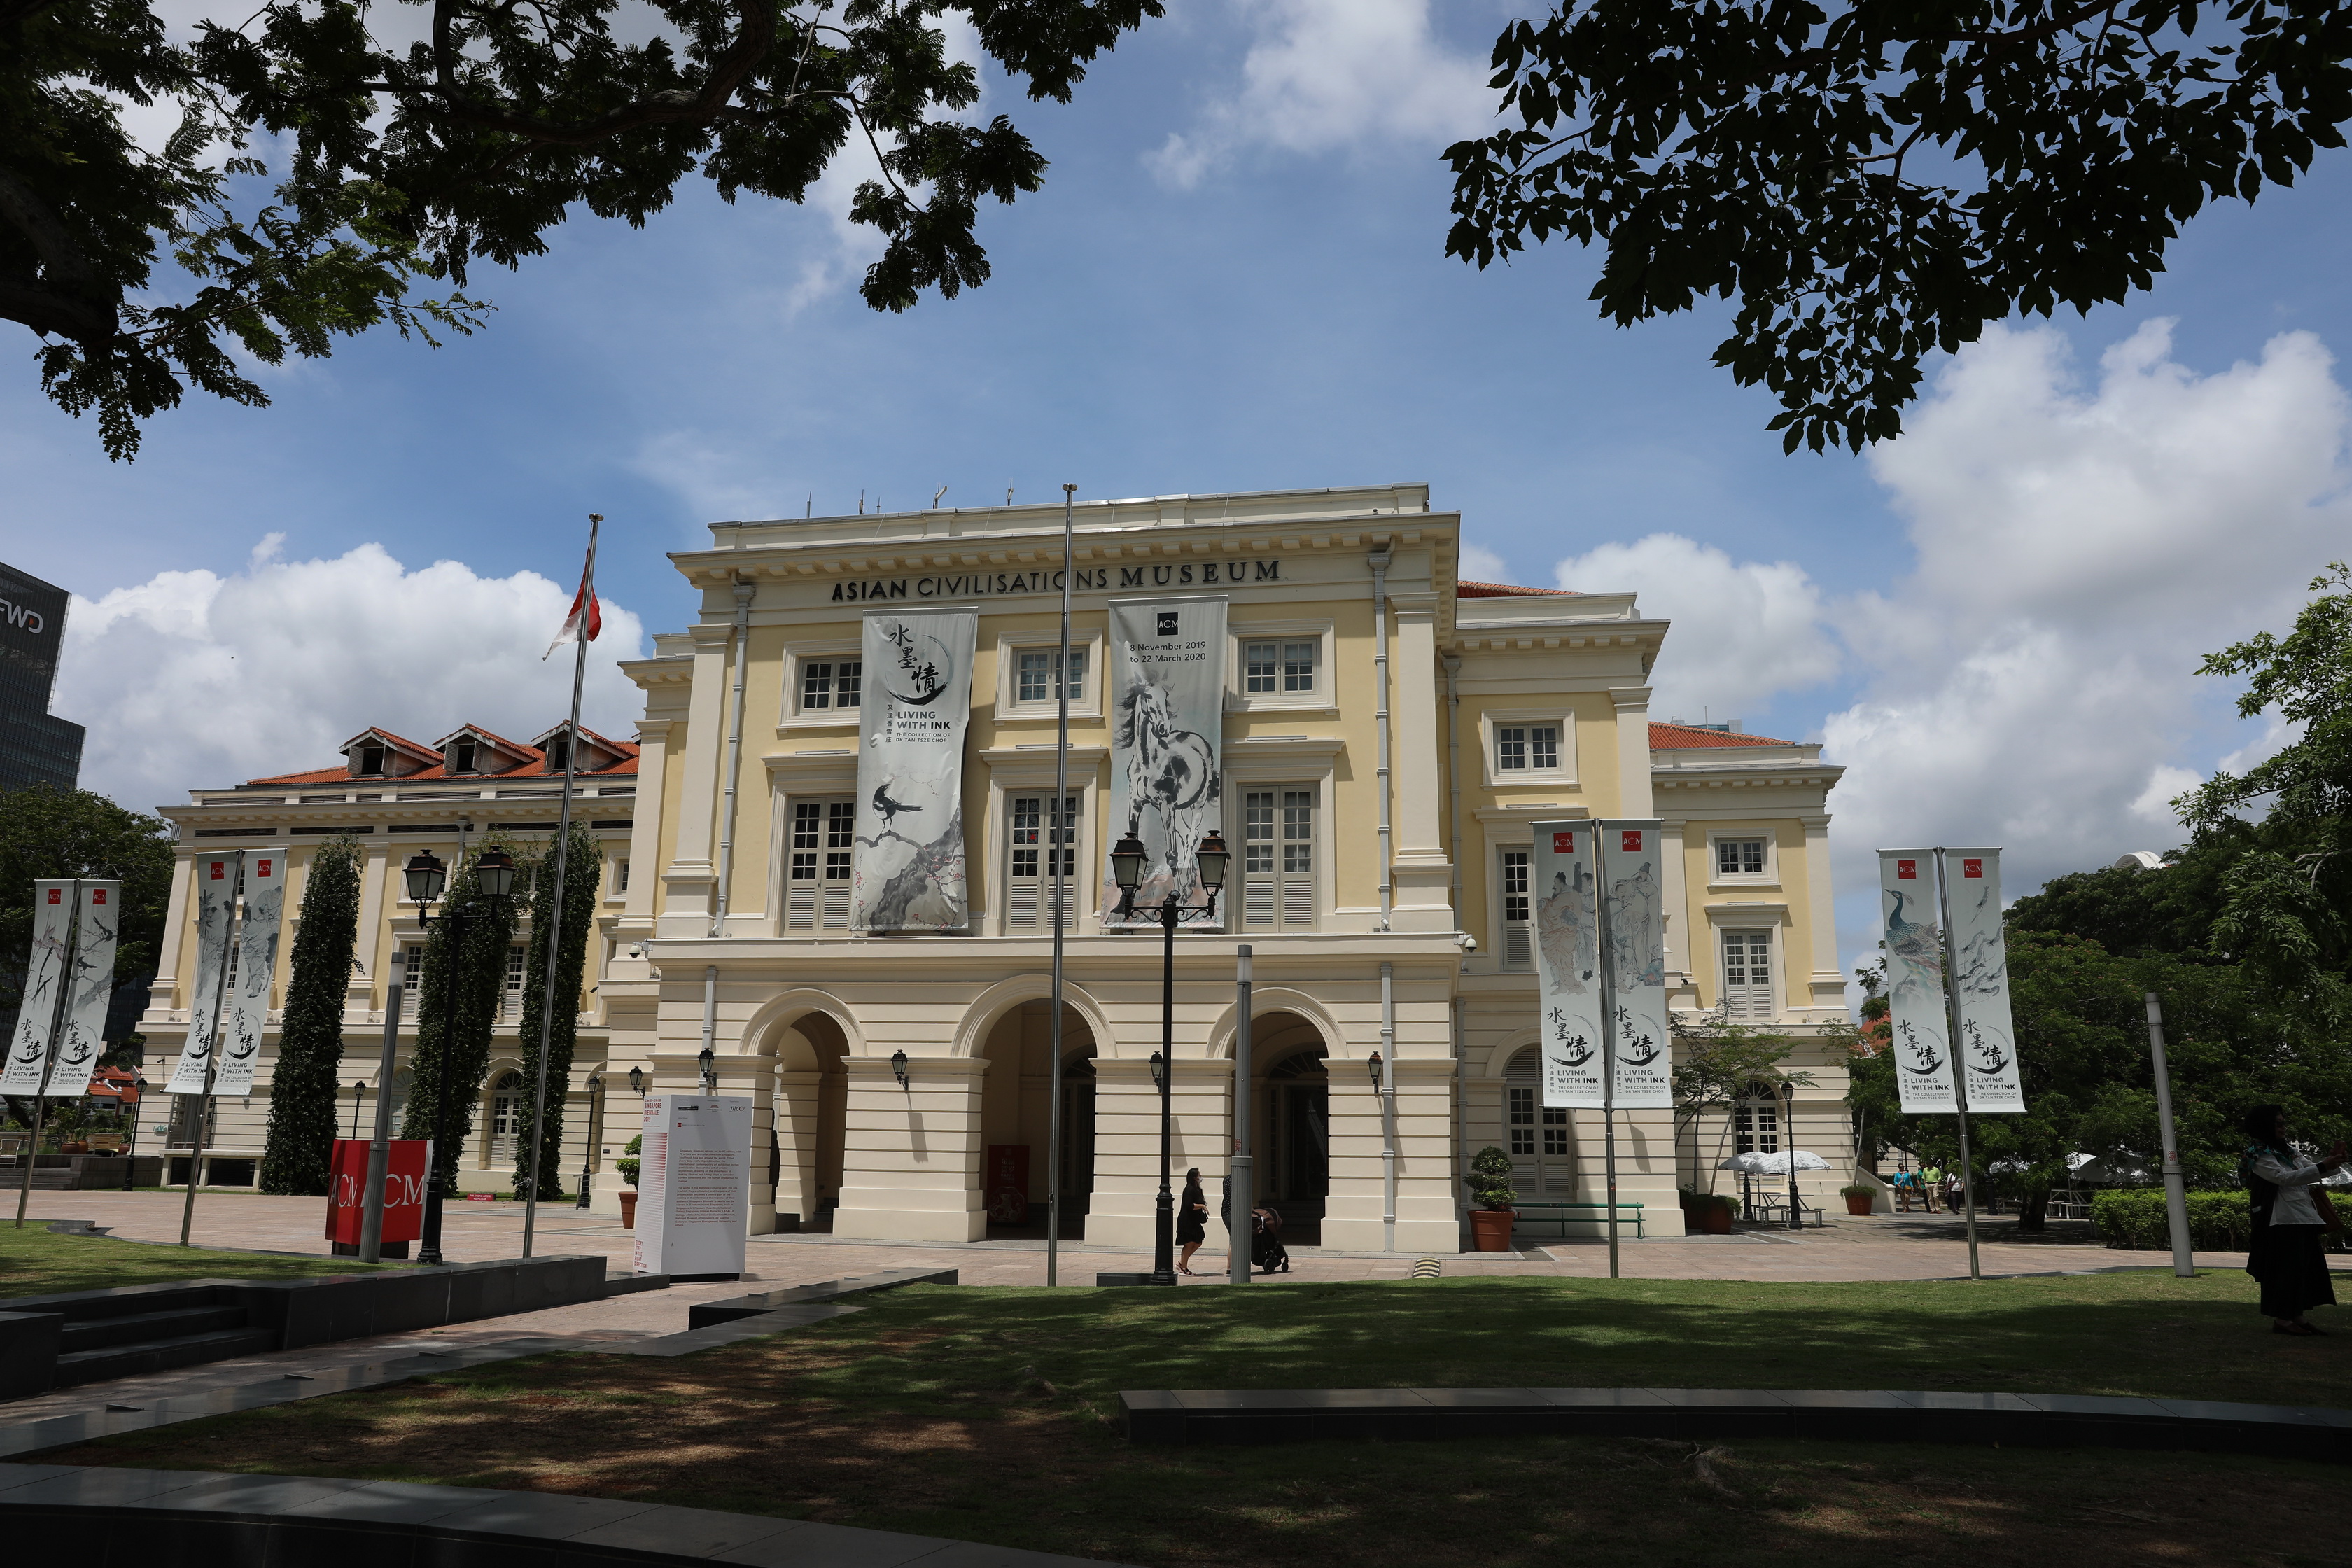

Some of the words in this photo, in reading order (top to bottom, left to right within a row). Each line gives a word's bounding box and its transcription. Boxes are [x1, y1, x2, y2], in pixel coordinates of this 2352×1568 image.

[832, 580, 906, 601] ASIAN
[917, 569, 1107, 596] CIVILISATIONS
[1120, 561, 1280, 586] MUSEUM
[1158, 620, 1178, 628] ACM
[889, 624, 939, 693] 水墨情
[1138, 643, 1182, 651] November
[1155, 654, 1181, 662] March
[1555, 839, 1574, 847] ACM
[20, 1018, 41, 1057] 水墨情
[66, 1018, 90, 1058] 水墨情
[194, 1009, 211, 1051] 水墨情
[233, 1007, 254, 1051] 水墨情
[1547, 1006, 1588, 1058] 水墨情
[1613, 1004, 1653, 1057] 水墨情
[1897, 1018, 1936, 1066] 水墨情
[1962, 1018, 2002, 1065] 水墨情
[330, 1173, 358, 1208] ACM
